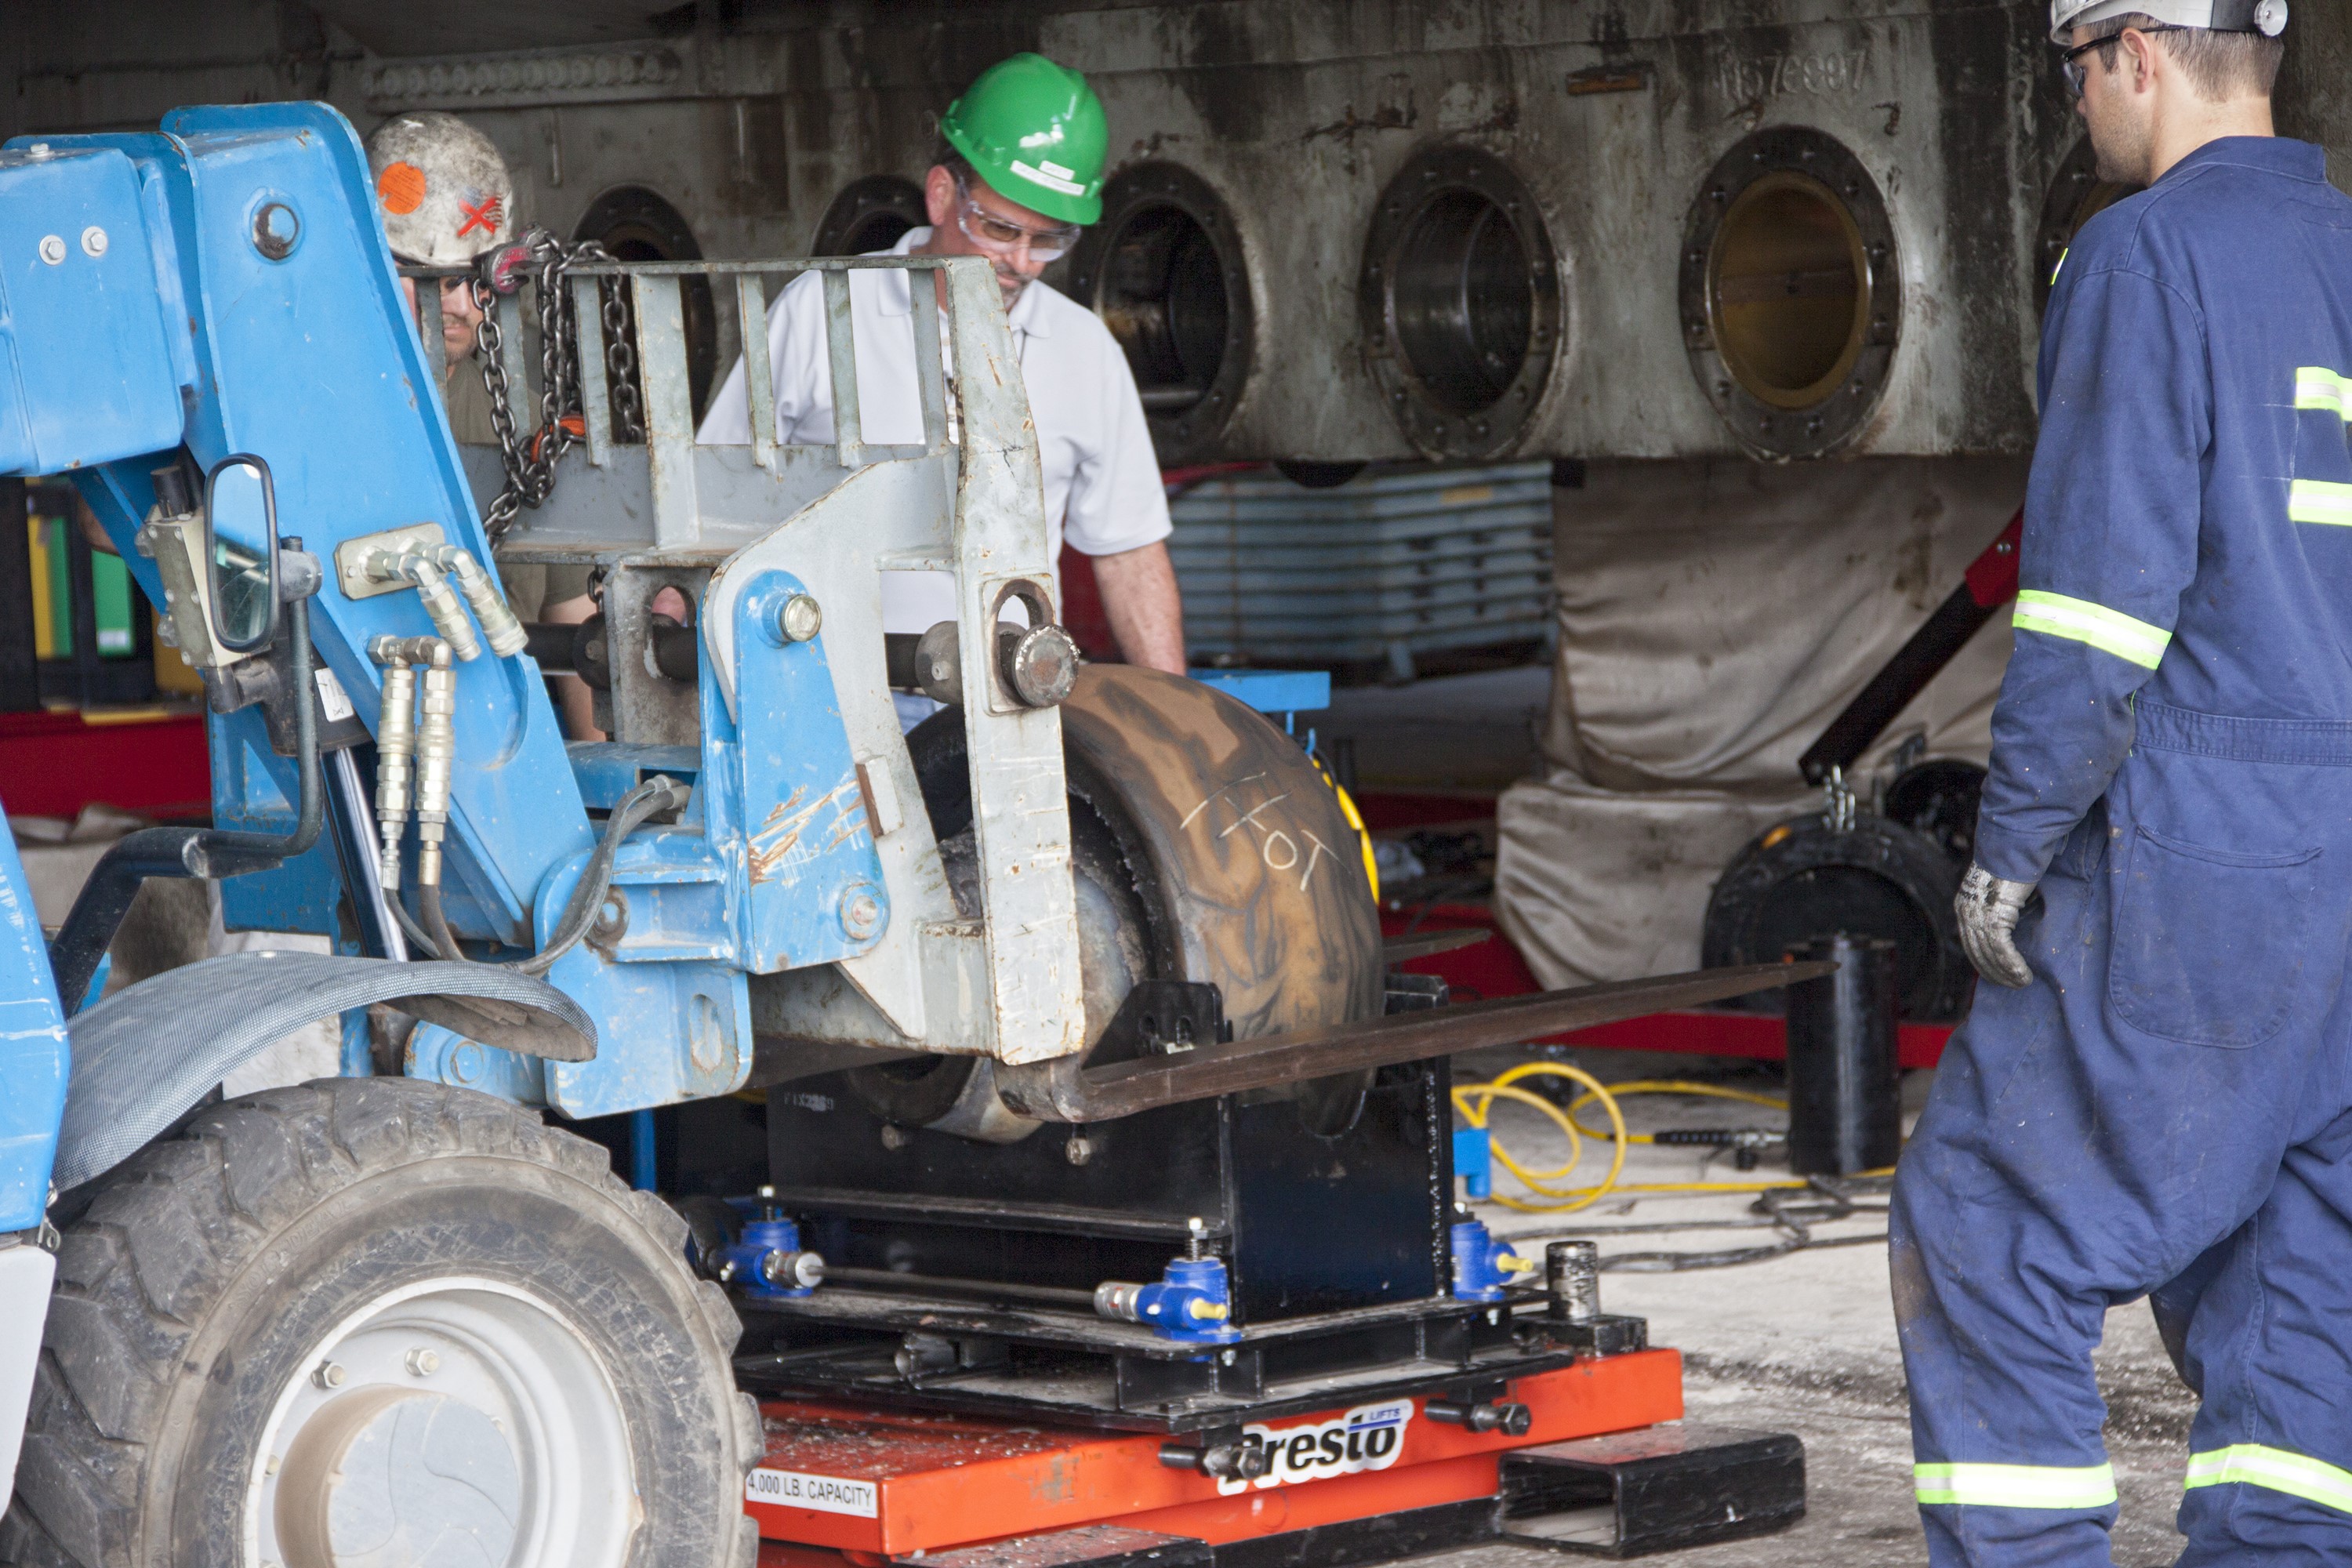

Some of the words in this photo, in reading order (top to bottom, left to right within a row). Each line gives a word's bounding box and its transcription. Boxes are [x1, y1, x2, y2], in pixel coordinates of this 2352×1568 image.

[1370, 1408, 1400, 1421] LIFTS
[748, 1472, 780, 1495] 4,000
[784, 1477, 804, 1497] LB.
[808, 1480, 872, 1507] CAPACITY
